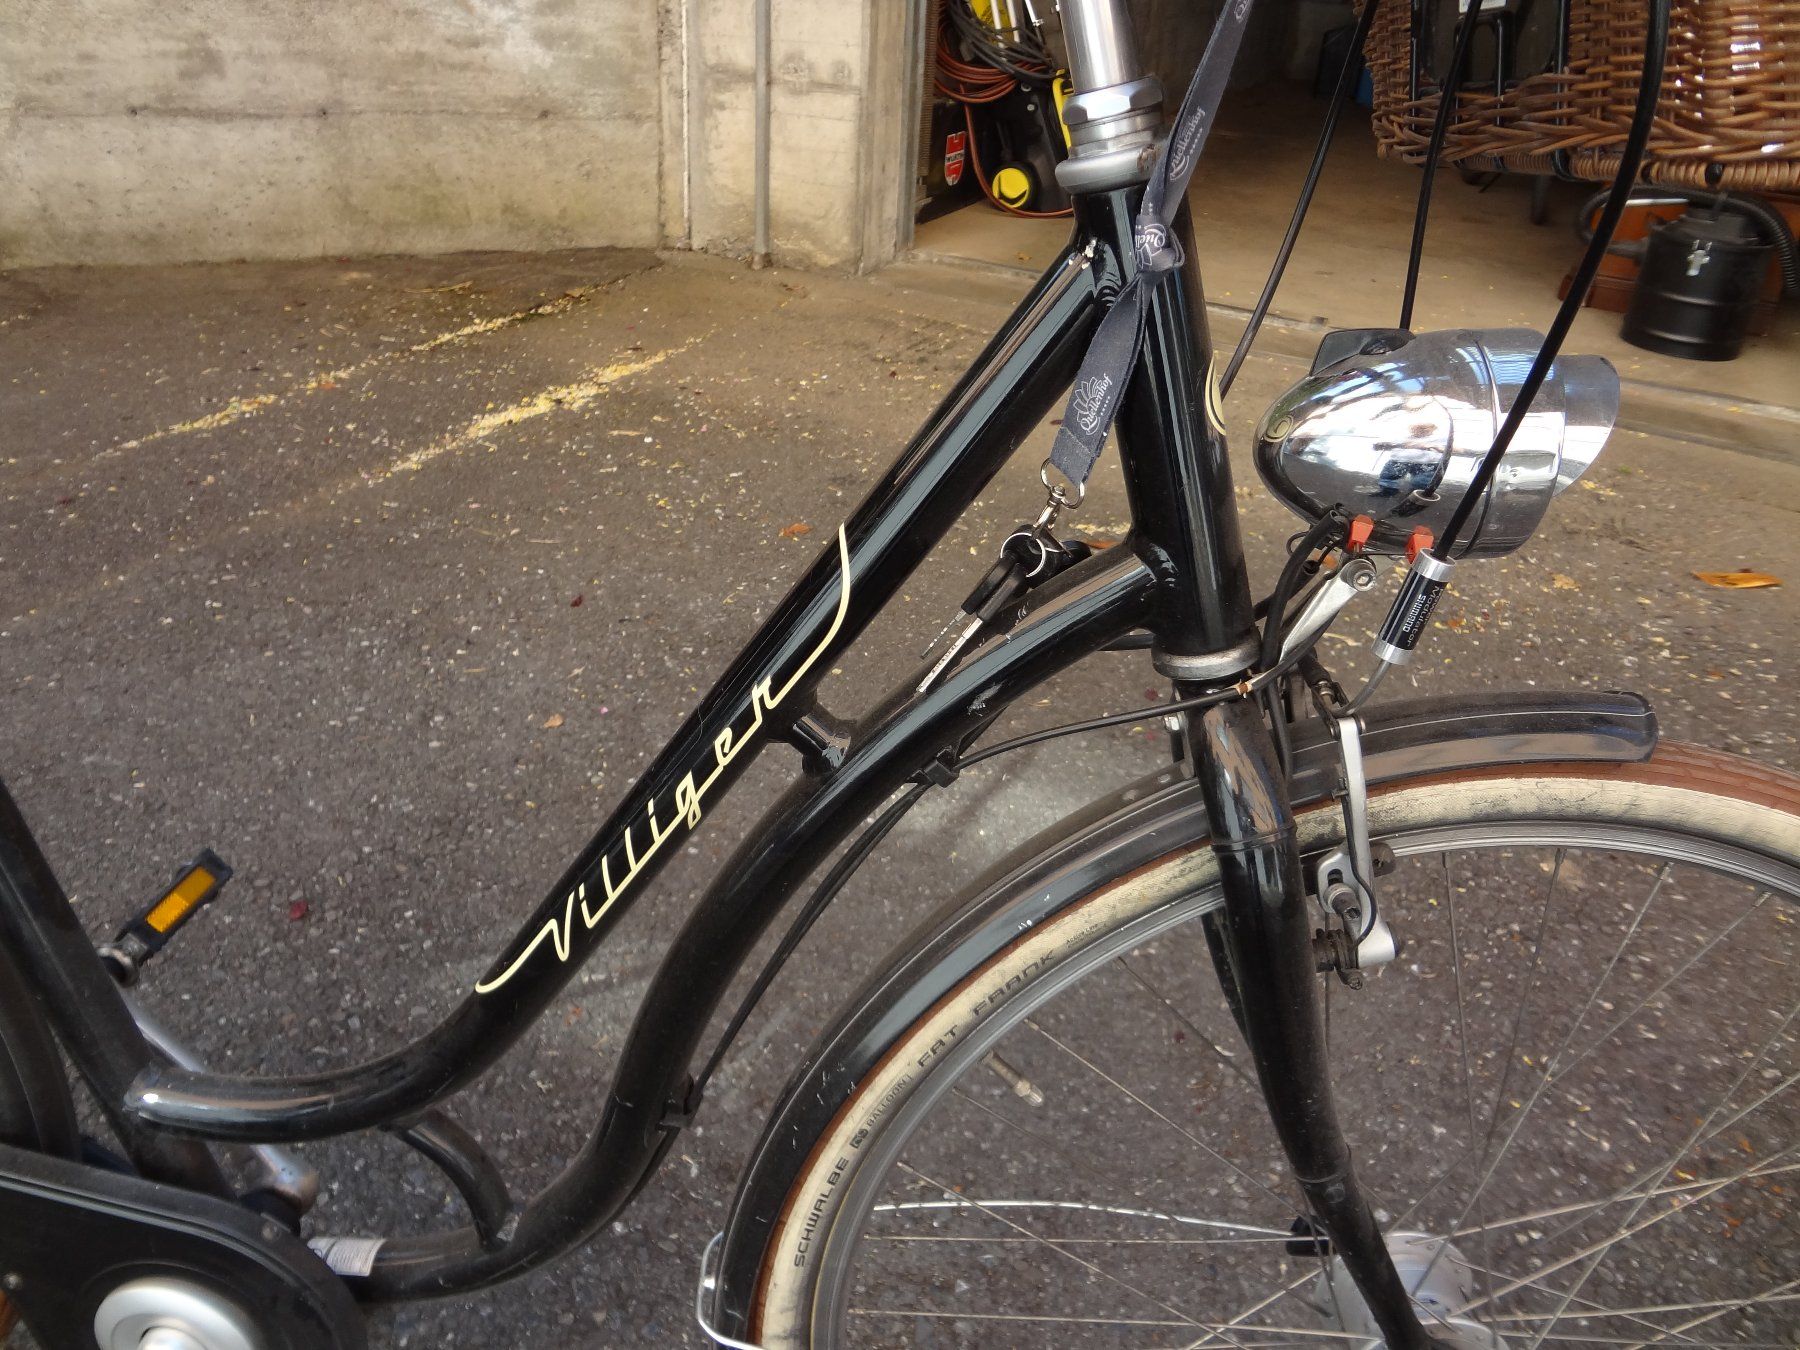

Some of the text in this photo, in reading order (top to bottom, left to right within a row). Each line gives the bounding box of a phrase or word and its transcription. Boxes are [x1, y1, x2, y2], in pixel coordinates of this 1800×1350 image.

[1080, 373, 1113, 435] Quellenhof
[1402, 594, 1427, 633] SHIMANO
[1407, 586, 1438, 647] Modulator
[794, 1156, 849, 1268] SCHWALBE
[917, 1024, 958, 1068] FAT
[972, 951, 1055, 1017] FRANK
